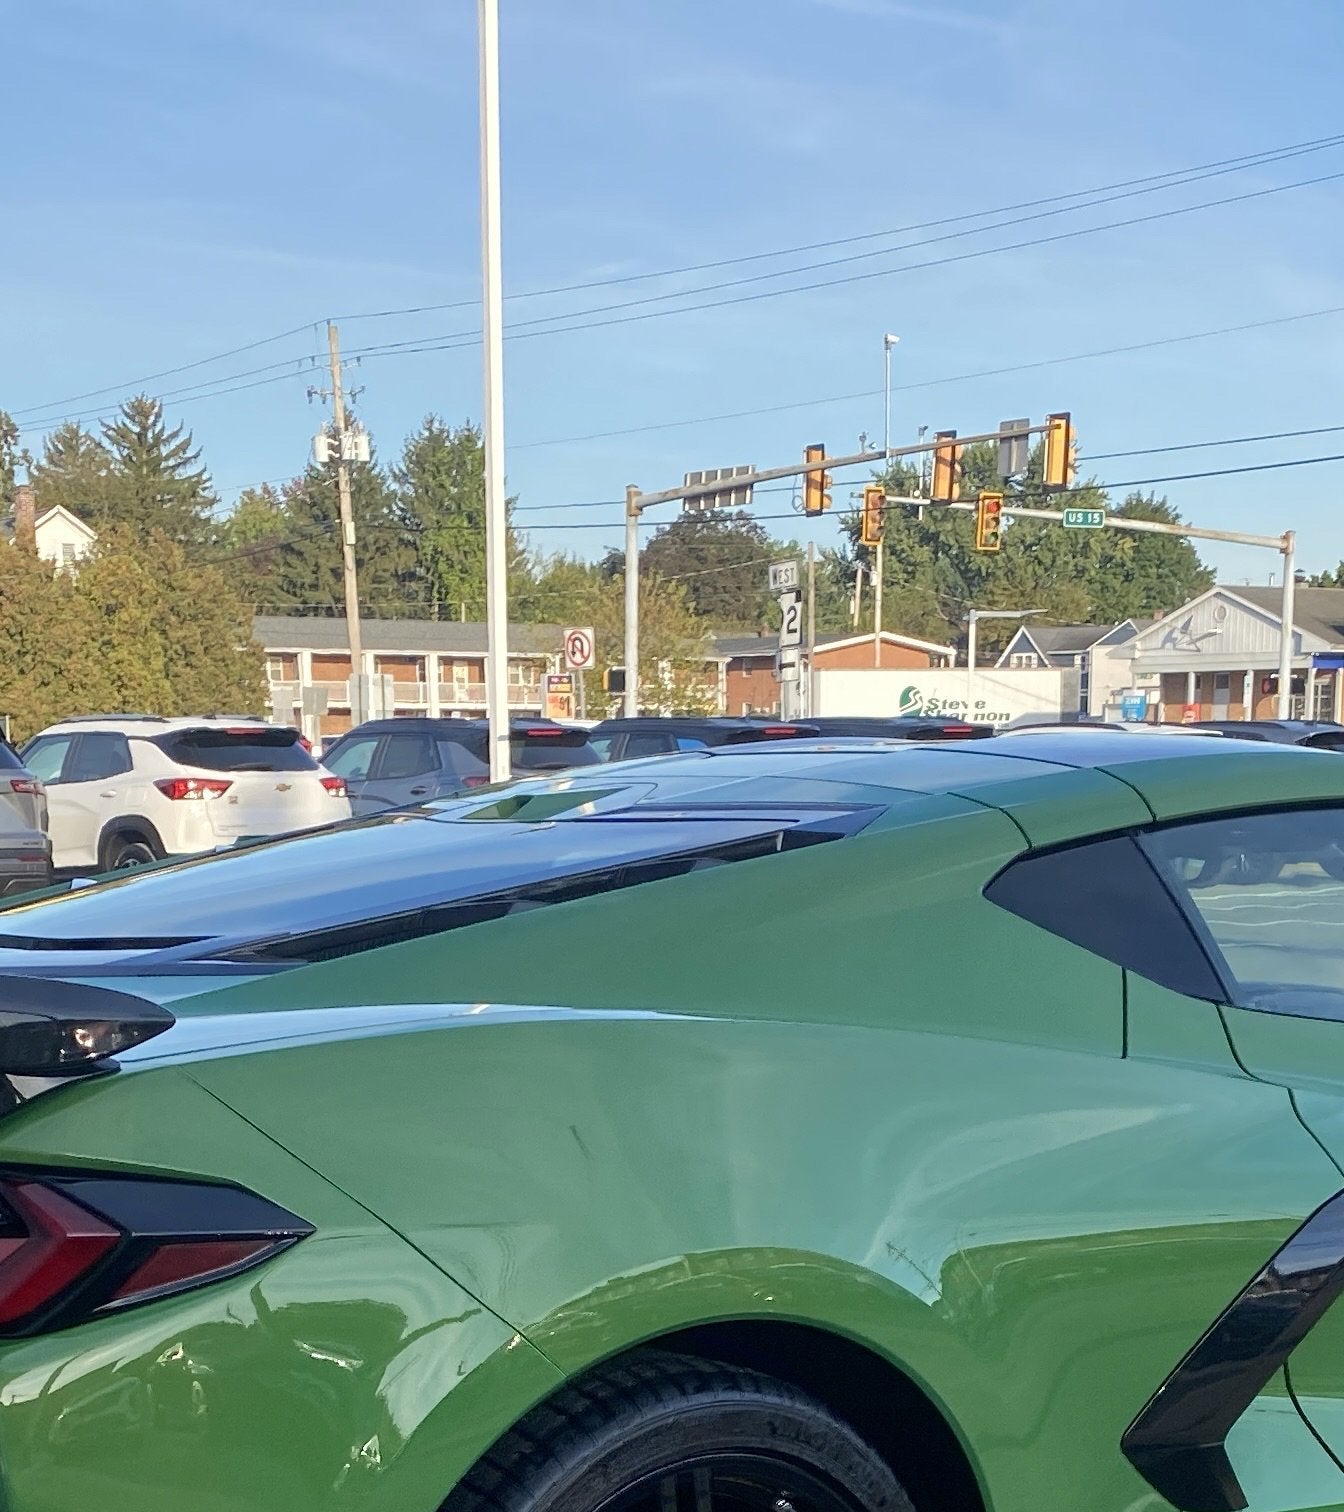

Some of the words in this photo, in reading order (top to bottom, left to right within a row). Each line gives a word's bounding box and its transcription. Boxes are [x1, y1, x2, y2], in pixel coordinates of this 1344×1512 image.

[1068, 512, 1084, 523] US
[1087, 512, 1100, 524] 15
[772, 567, 795, 586] WEST
